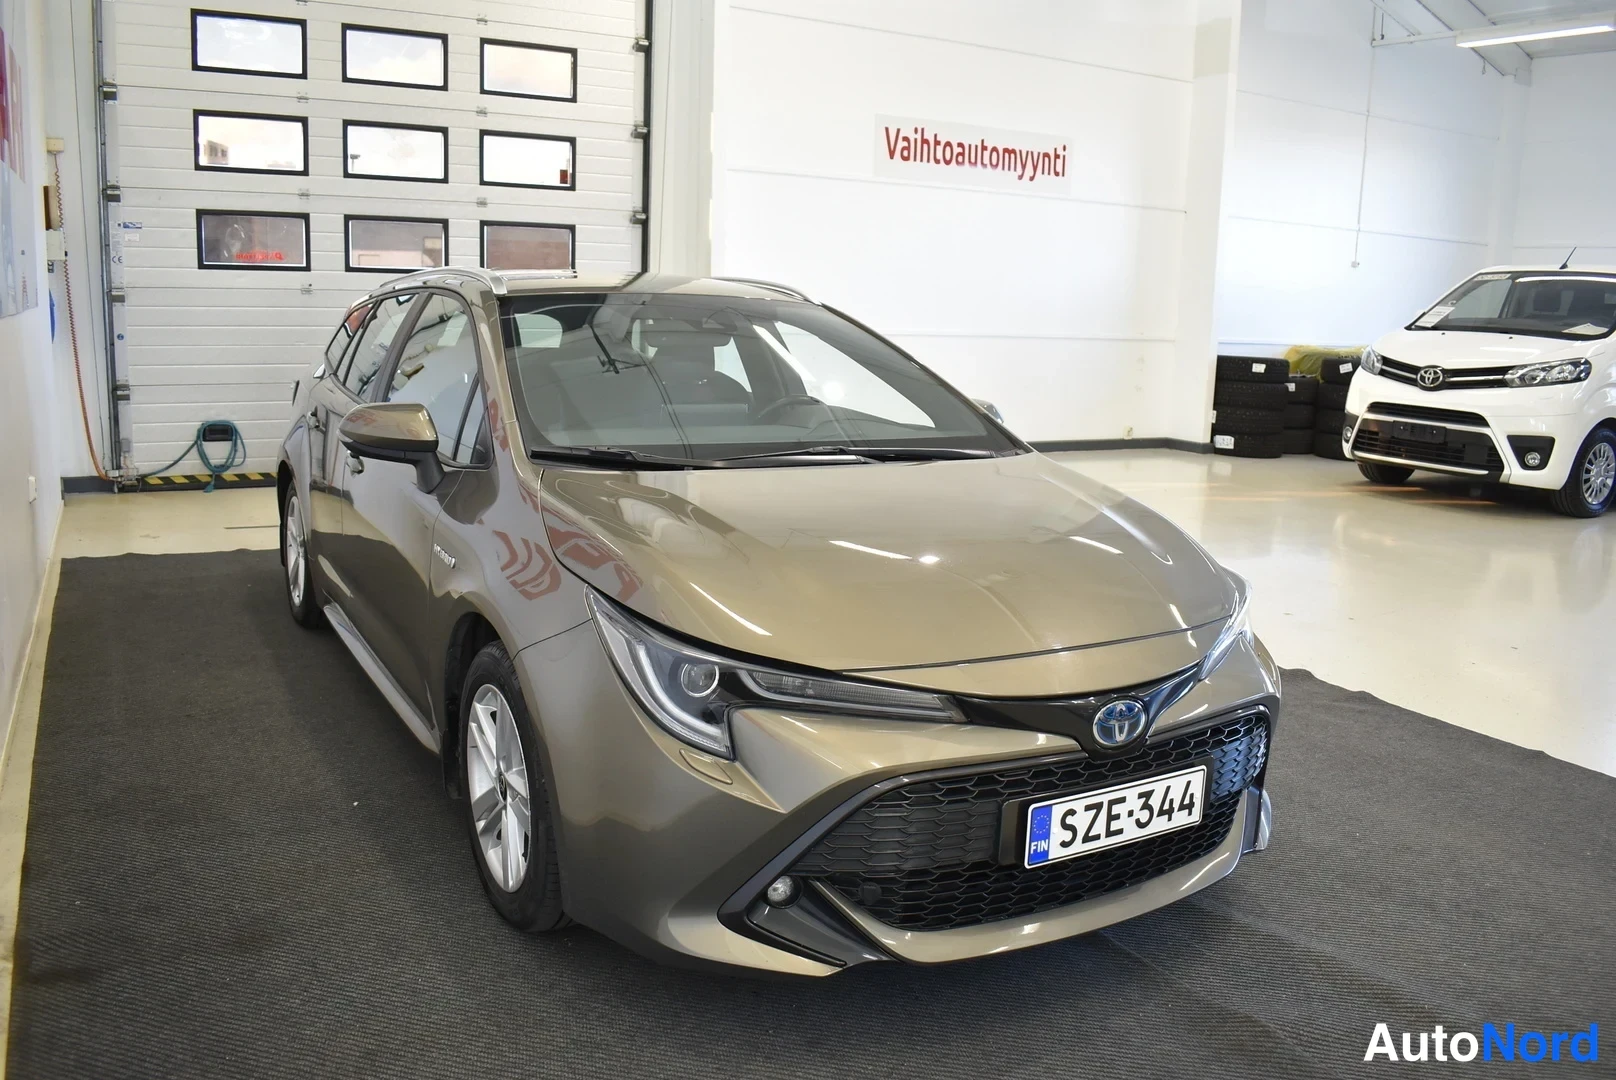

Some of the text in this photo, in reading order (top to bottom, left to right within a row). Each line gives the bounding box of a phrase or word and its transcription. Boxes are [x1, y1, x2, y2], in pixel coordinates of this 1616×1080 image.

[885, 126, 1067, 182] Vaihtoautomyynti
[1059, 779, 1195, 849] SZE-344
[1030, 839, 1049, 855] FIN
